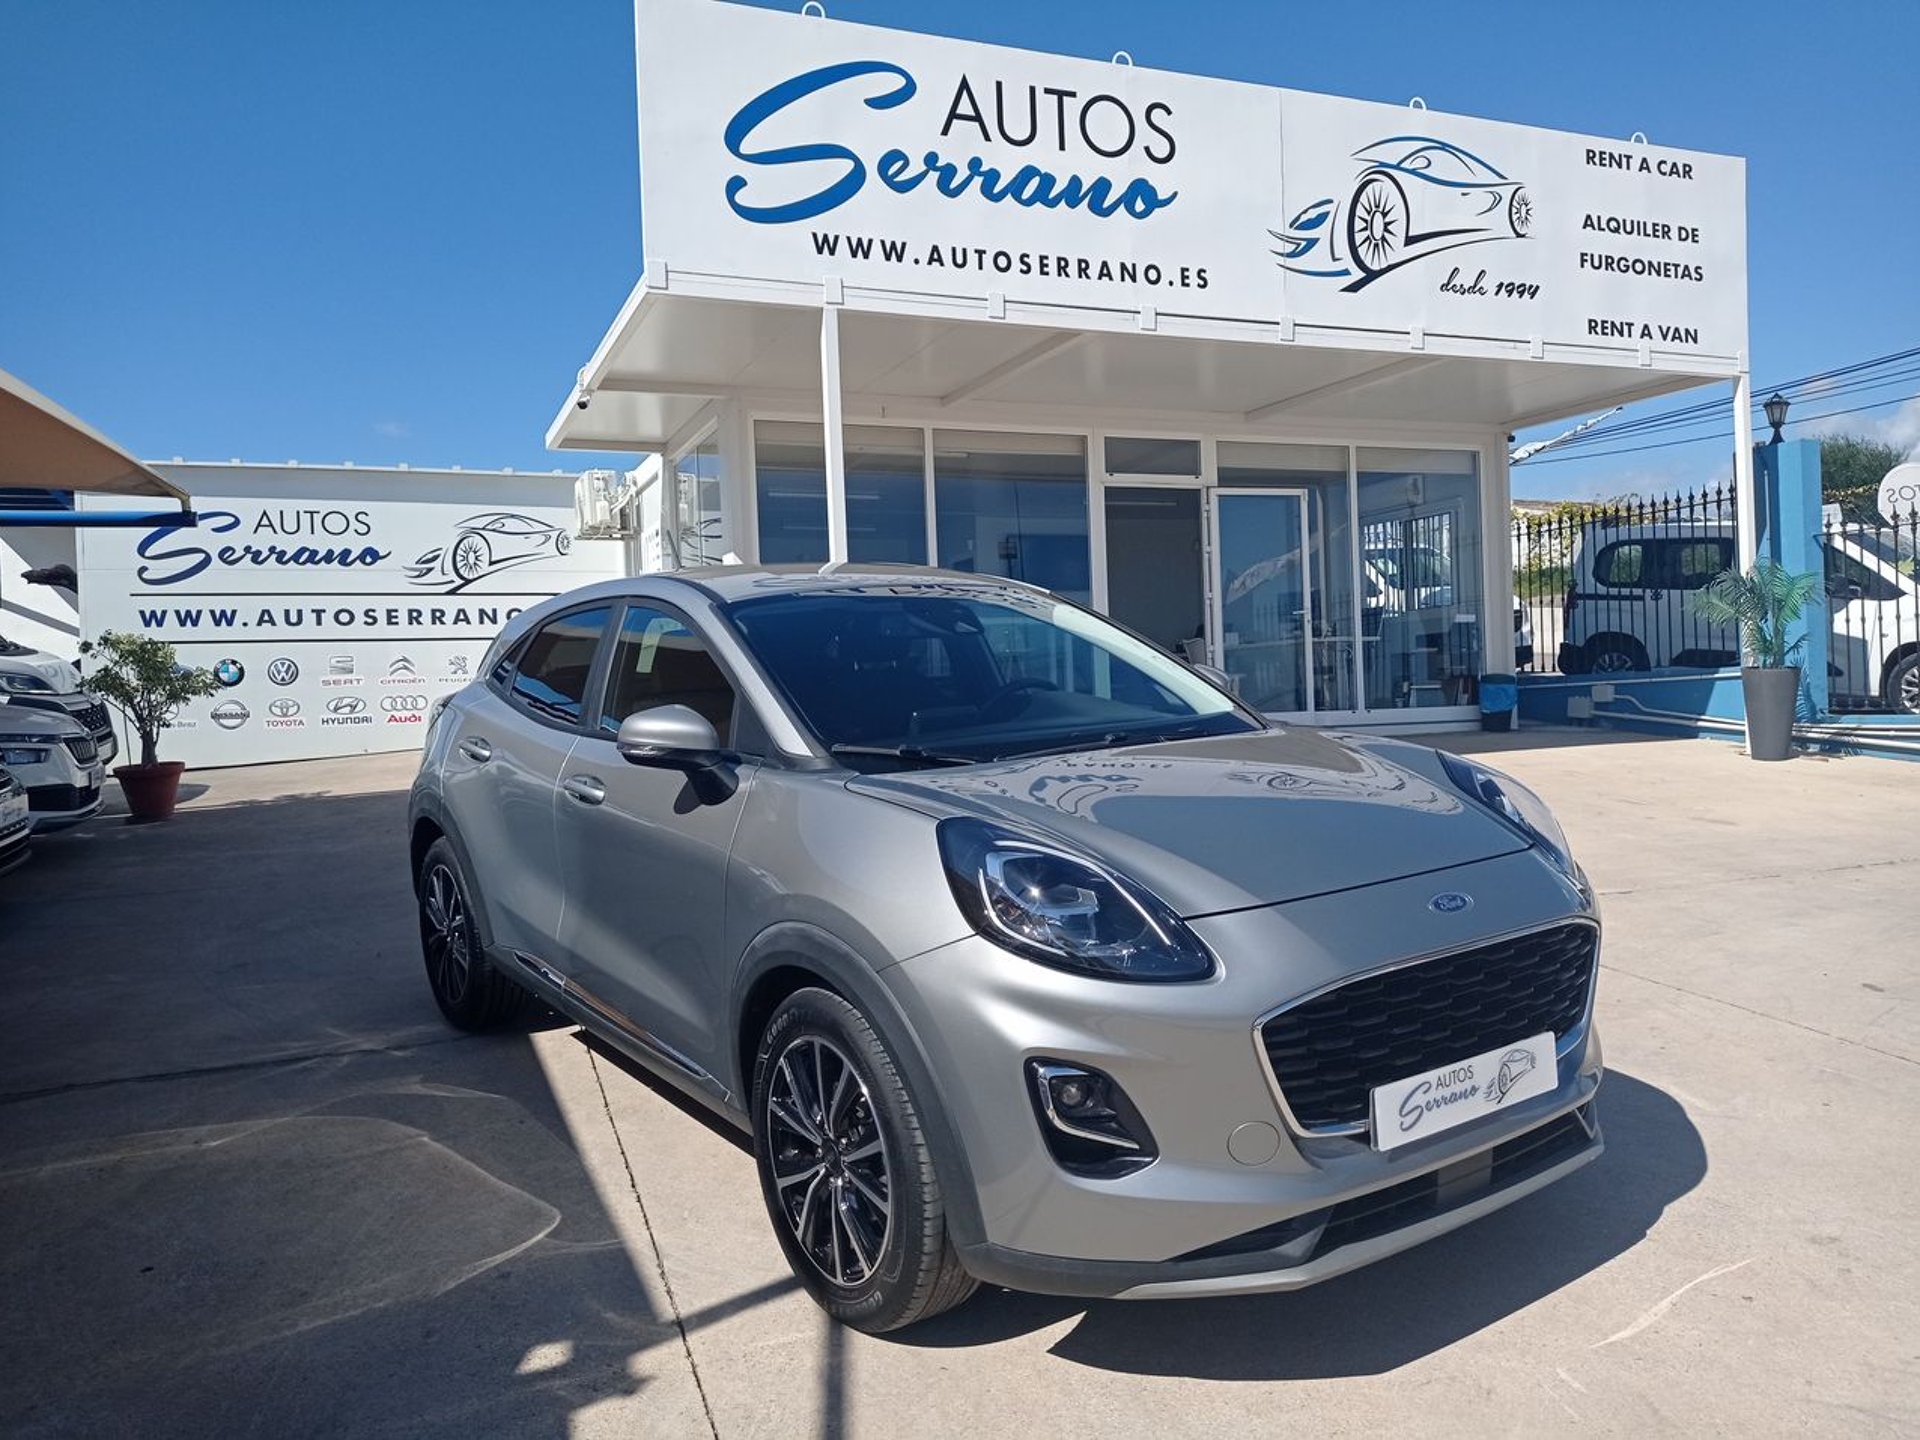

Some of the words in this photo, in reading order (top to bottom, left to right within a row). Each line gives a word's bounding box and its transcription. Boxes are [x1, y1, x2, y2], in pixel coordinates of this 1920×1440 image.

[940, 73, 1176, 165] AUTOS
[724, 60, 1179, 225] Serrano
[1585, 148, 1636, 171] RENT
[1638, 157, 1653, 174] A
[1656, 159, 1694, 180] CAR
[1582, 214, 1673, 241] ALQUILER
[1677, 225, 1700, 244] DE
[811, 231, 1210, 290] WWW.AUTOSERRANO.ES
[1579, 252, 1704, 282] FURGONETAS
[1440, 266, 1488, 296] desde
[1493, 281, 1540, 300] 1994
[1587, 318, 1637, 338] RENT
[1639, 323, 1653, 340] A
[1657, 324, 1698, 345] VAN
[253, 509, 372, 536] AUTOS
[136, 511, 392, 586] Serrano
[265, 719, 305, 728] TOYOTA
[321, 716, 373, 726] HYUNDAI
[387, 713, 422, 723] Audi
[1435, 1064, 1475, 1092] AUTOS
[1398, 1081, 1481, 1132] Serrano
